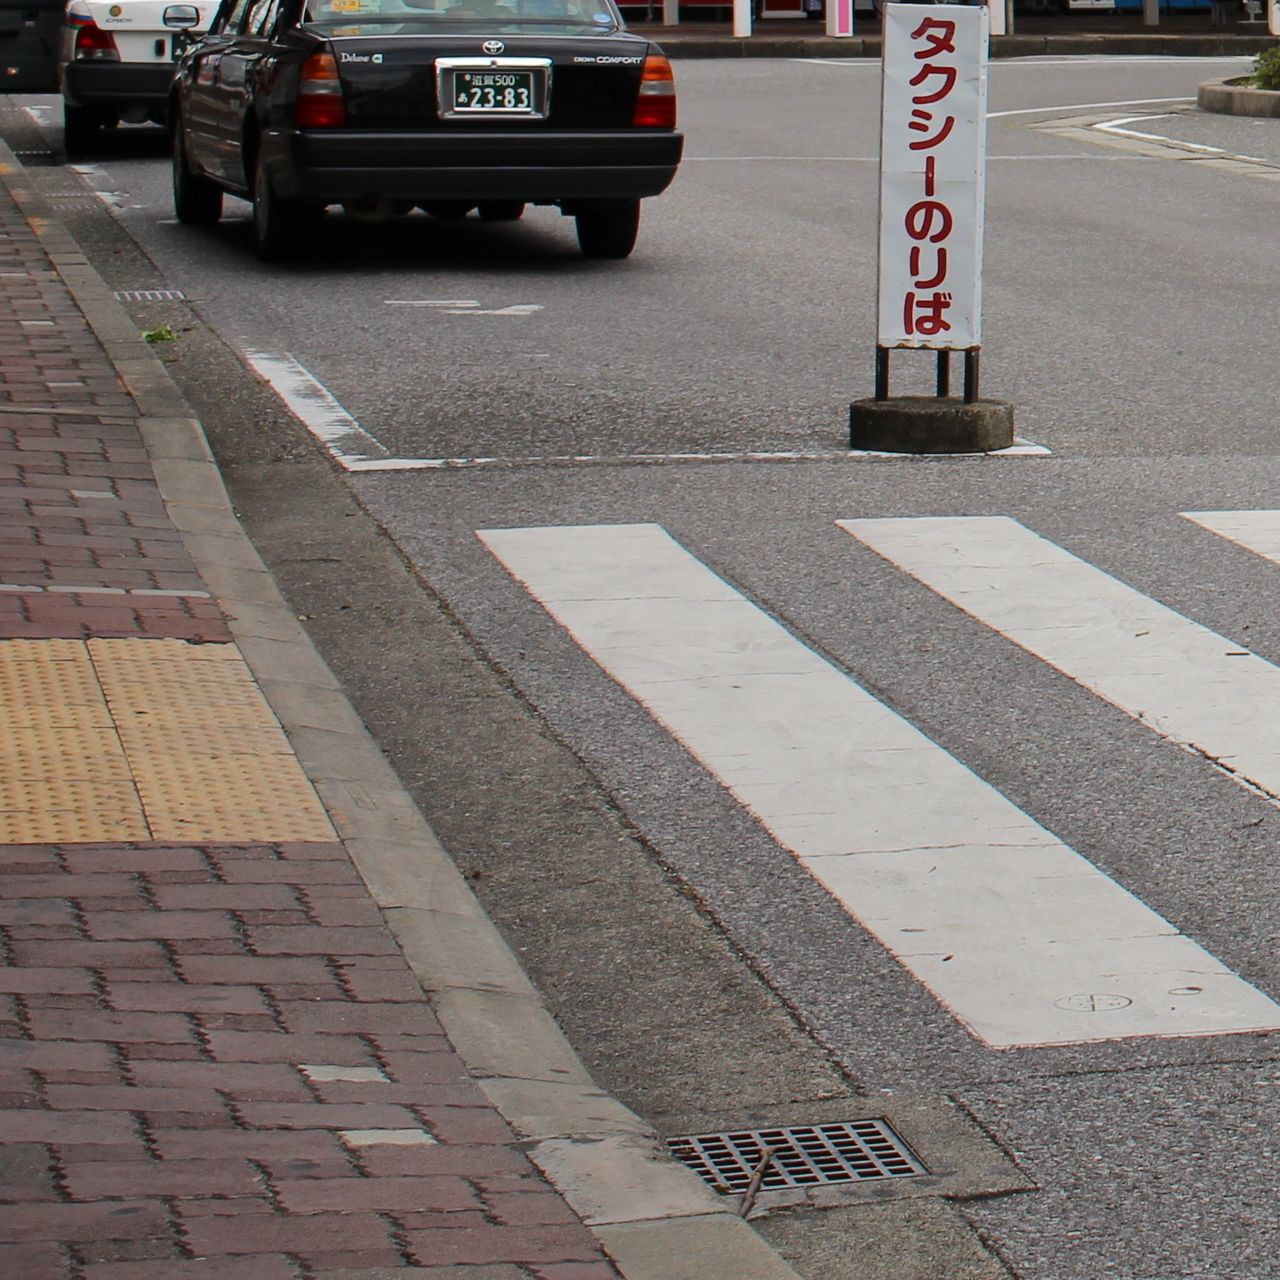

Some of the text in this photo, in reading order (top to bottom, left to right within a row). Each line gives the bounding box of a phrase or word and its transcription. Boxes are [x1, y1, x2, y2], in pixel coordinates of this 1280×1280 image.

[340, 52, 370, 63] Deluxe
[596, 55, 643, 64] COMFORT
[469, 87, 529, 108] 23-83
[903, 16, 958, 337] タクシーのりば
